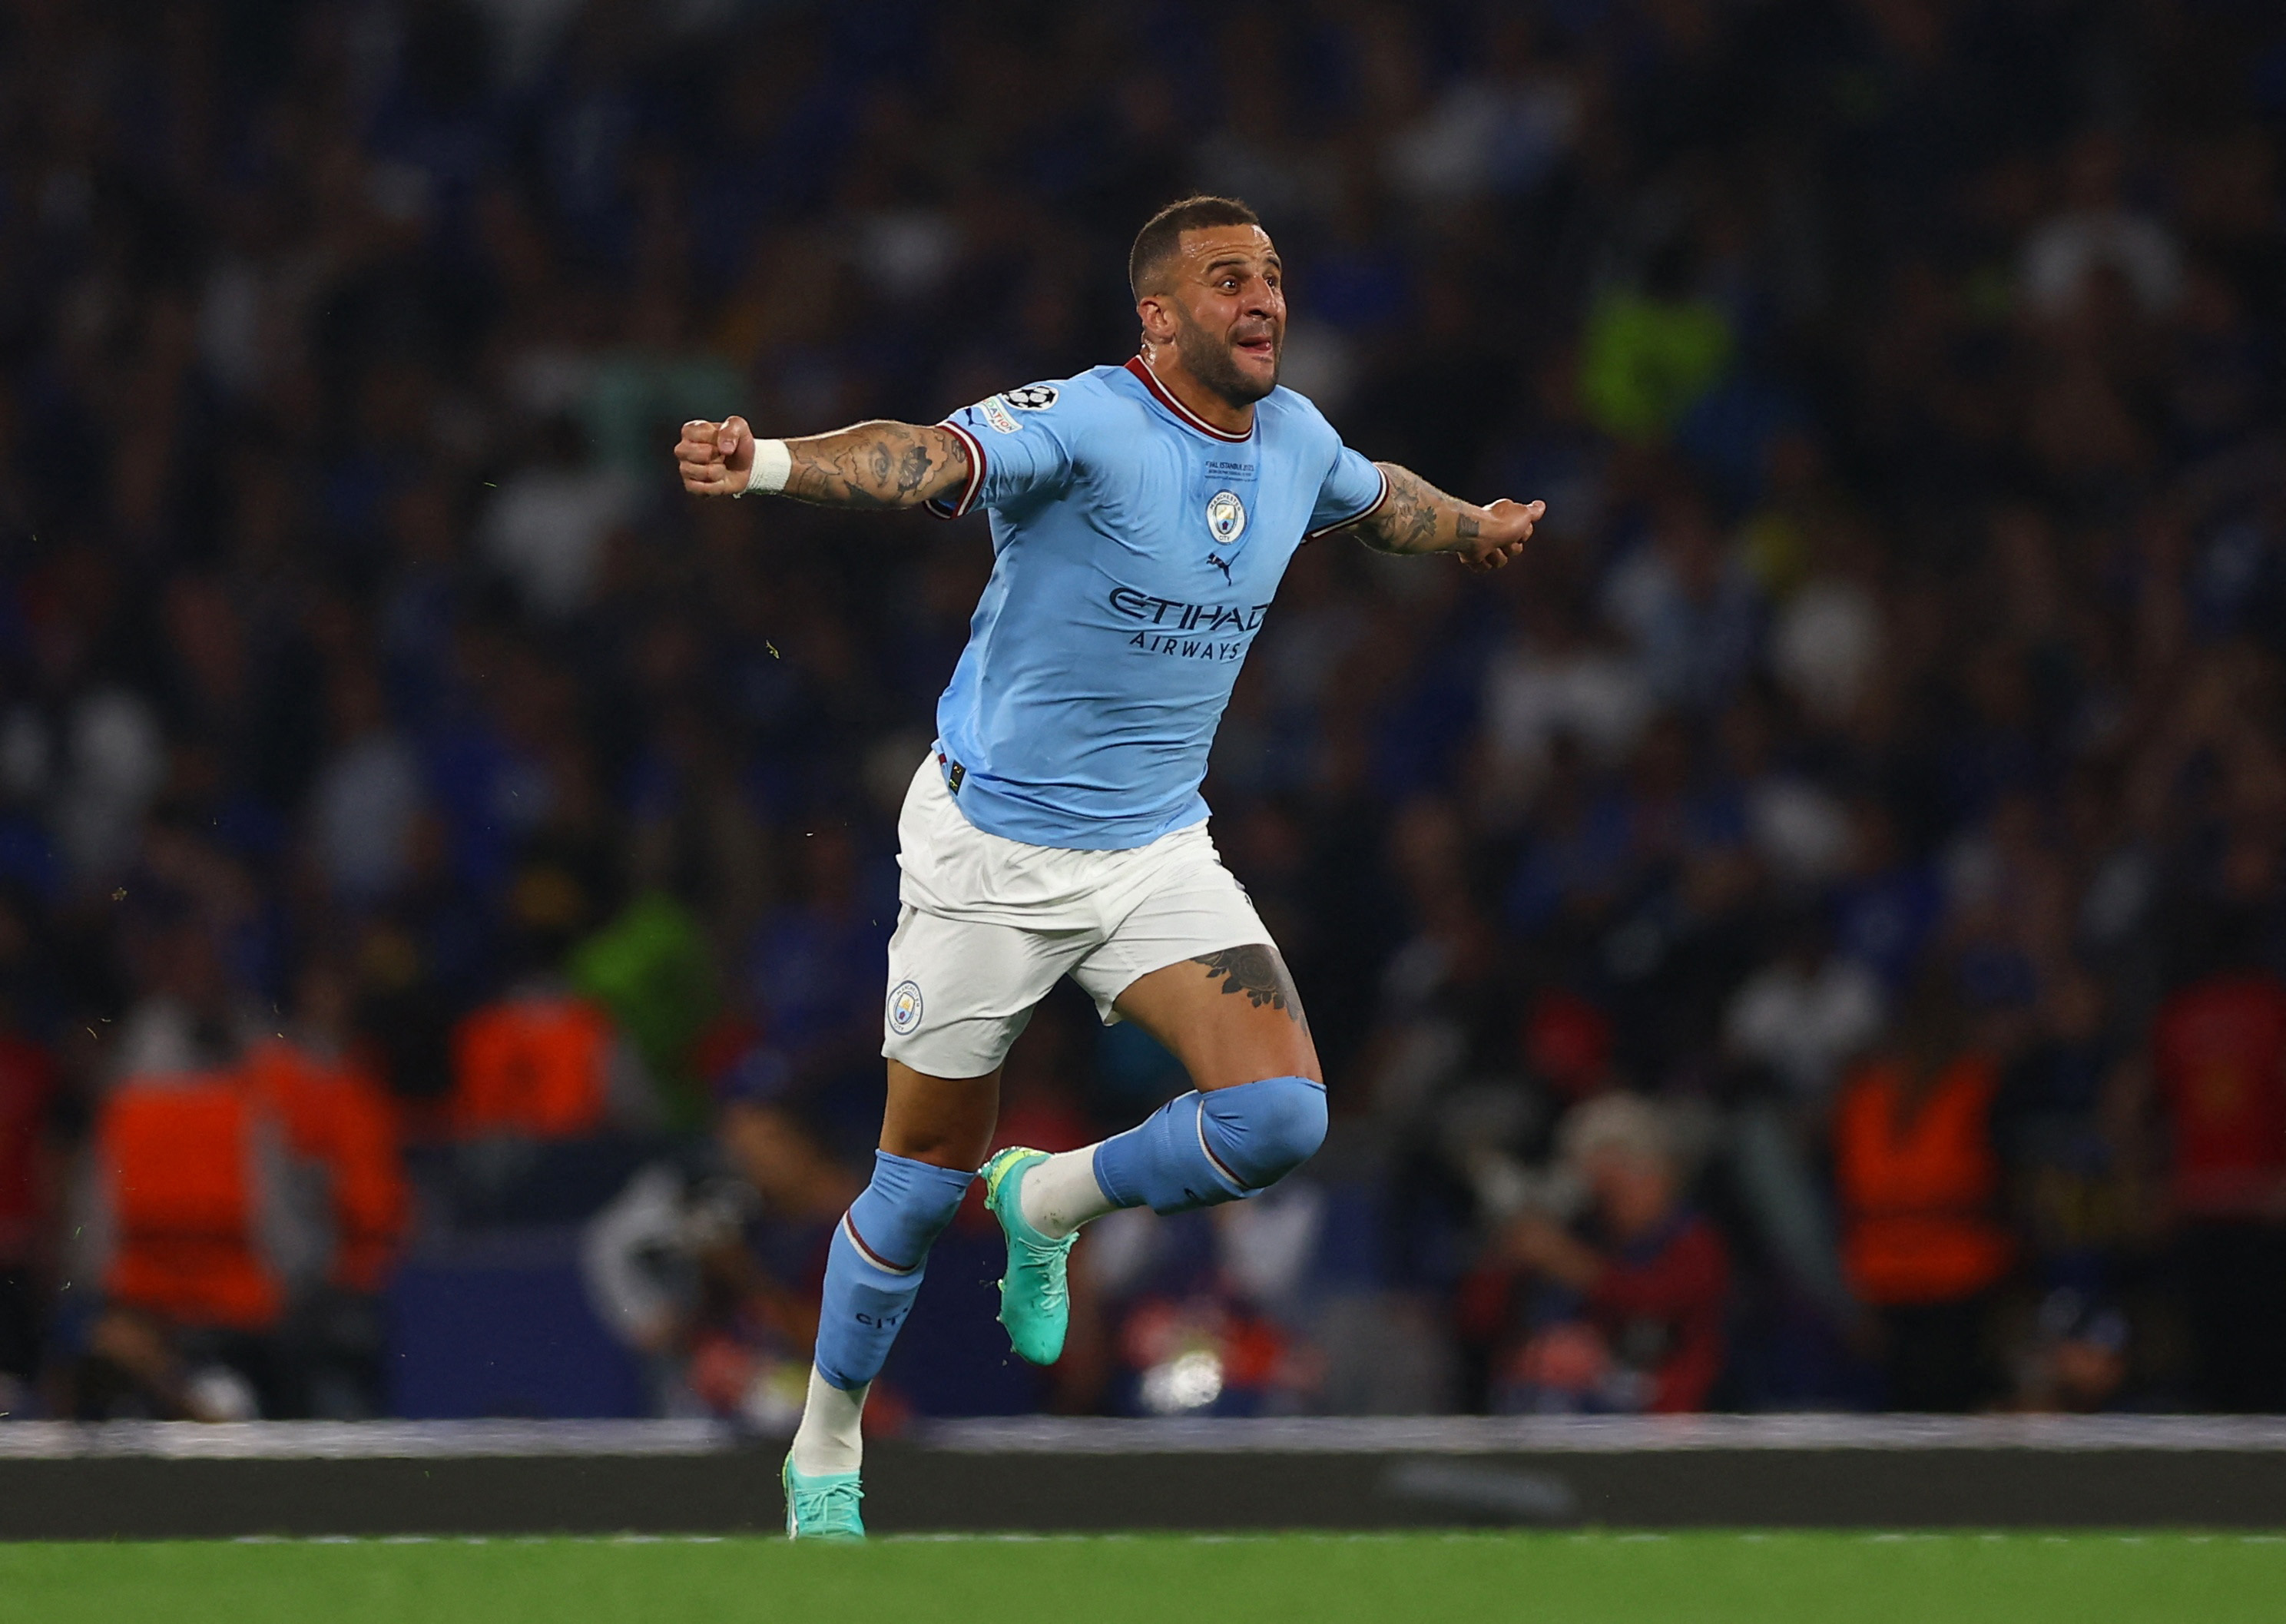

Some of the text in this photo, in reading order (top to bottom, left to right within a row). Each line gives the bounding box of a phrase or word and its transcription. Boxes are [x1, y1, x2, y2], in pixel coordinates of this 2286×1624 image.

[1210, 494, 1241, 511] MANCHESTER
[1109, 587, 1269, 631] ETIHAD
[1129, 631, 1241, 660] AIRWAYS
[896, 985, 920, 1008] MANCHESTER
[894, 1022, 904, 1031] CITY
